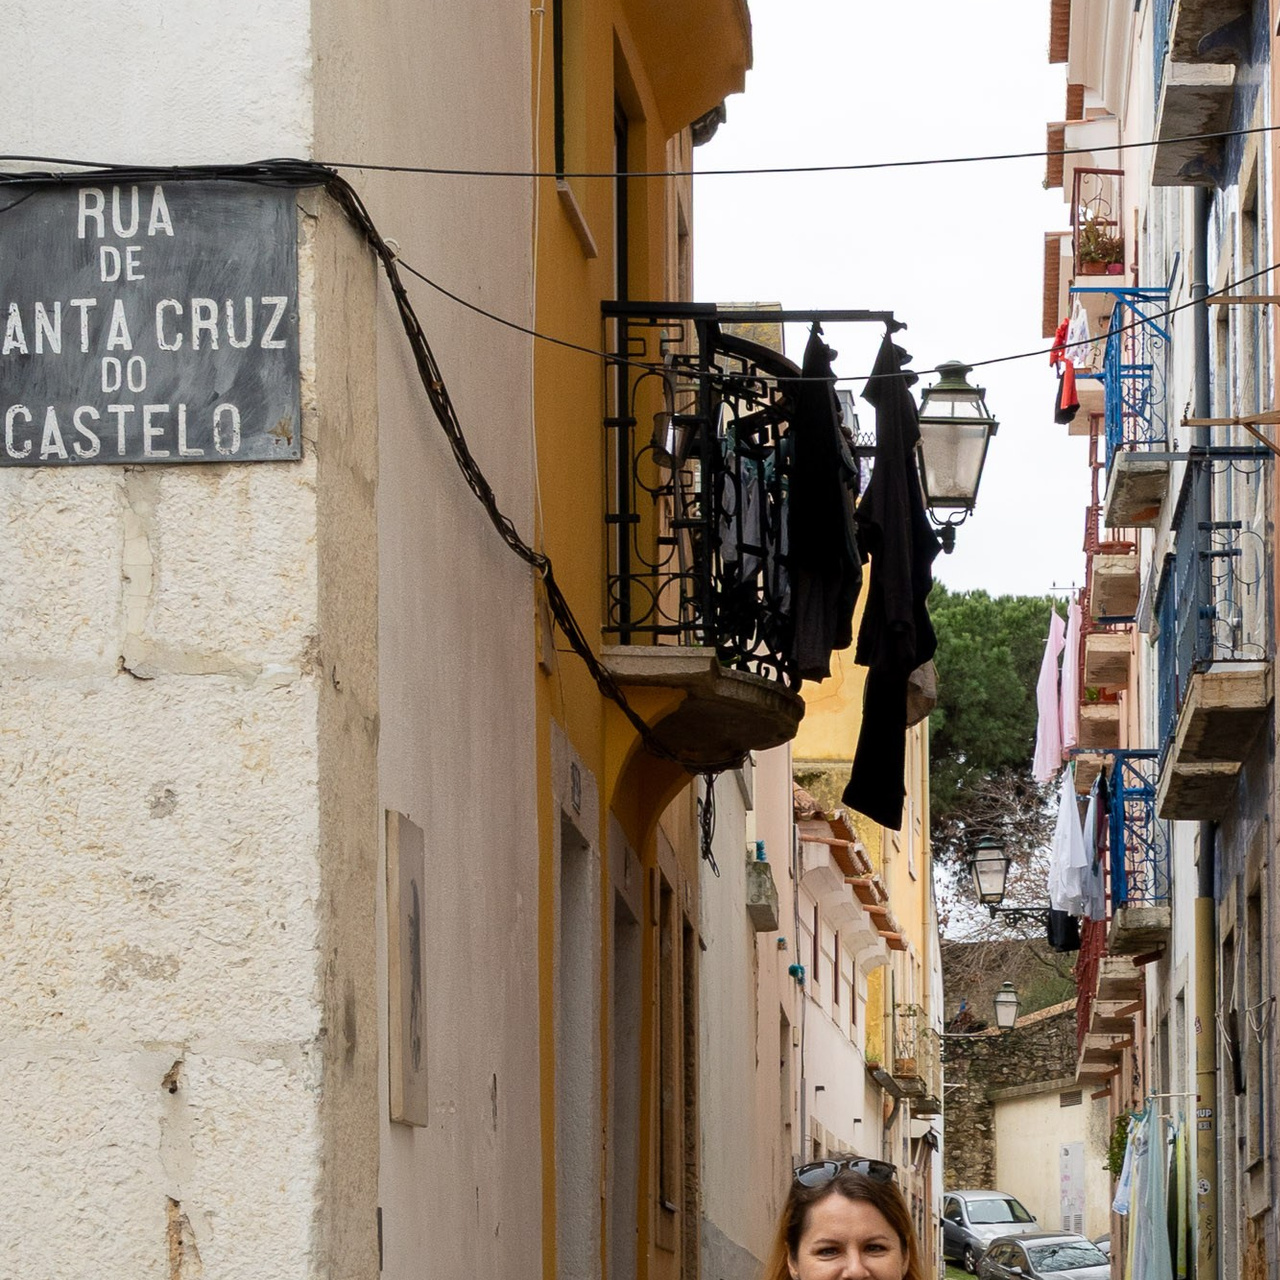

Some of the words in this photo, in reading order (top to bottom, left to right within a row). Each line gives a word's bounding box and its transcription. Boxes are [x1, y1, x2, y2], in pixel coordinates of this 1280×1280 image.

[77, 185, 174, 239] RUA
[100, 245, 145, 282] DE
[2, 298, 133, 355] ANTA
[155, 296, 288, 351] CRUZ
[101, 356, 147, 393] DO
[4, 403, 241, 460] CASTELO
